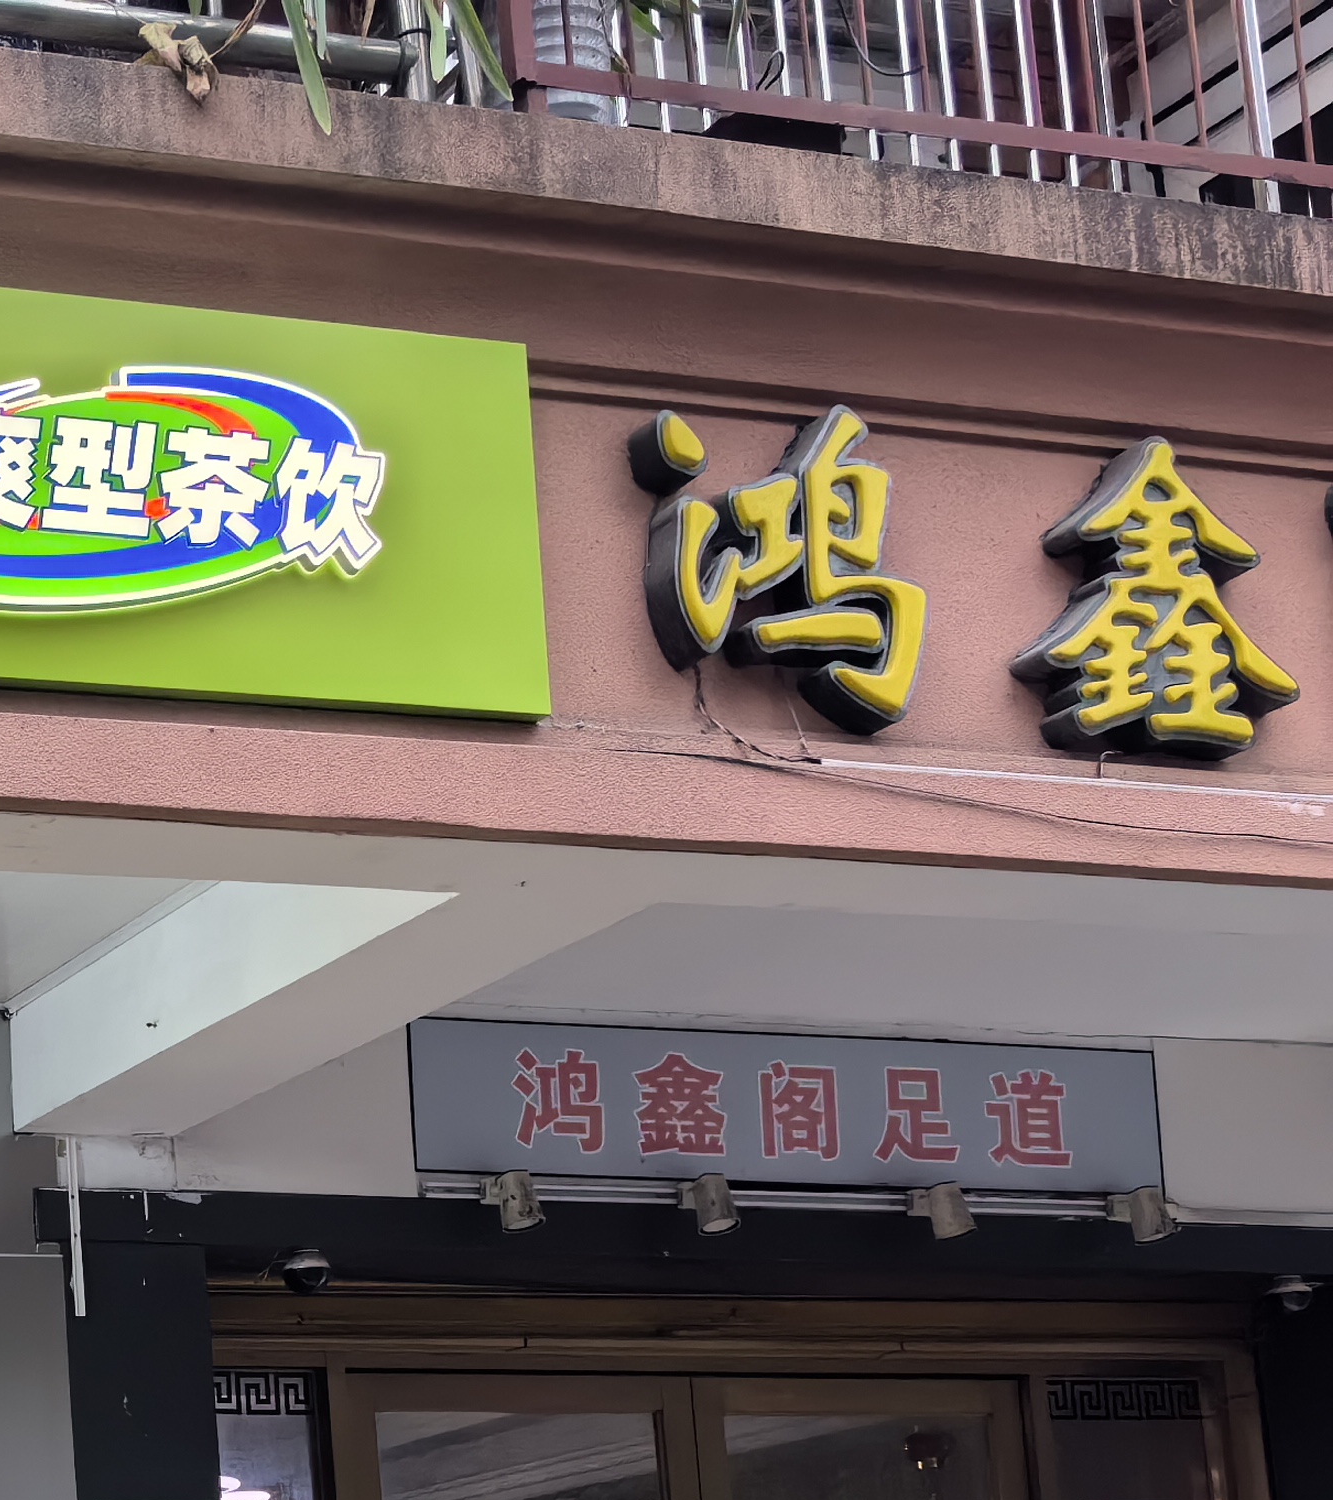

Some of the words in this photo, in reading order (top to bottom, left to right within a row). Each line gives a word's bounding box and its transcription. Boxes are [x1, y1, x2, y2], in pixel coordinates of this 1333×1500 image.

[511, 1047, 1074, 1169] 鸿鑫阁足道
